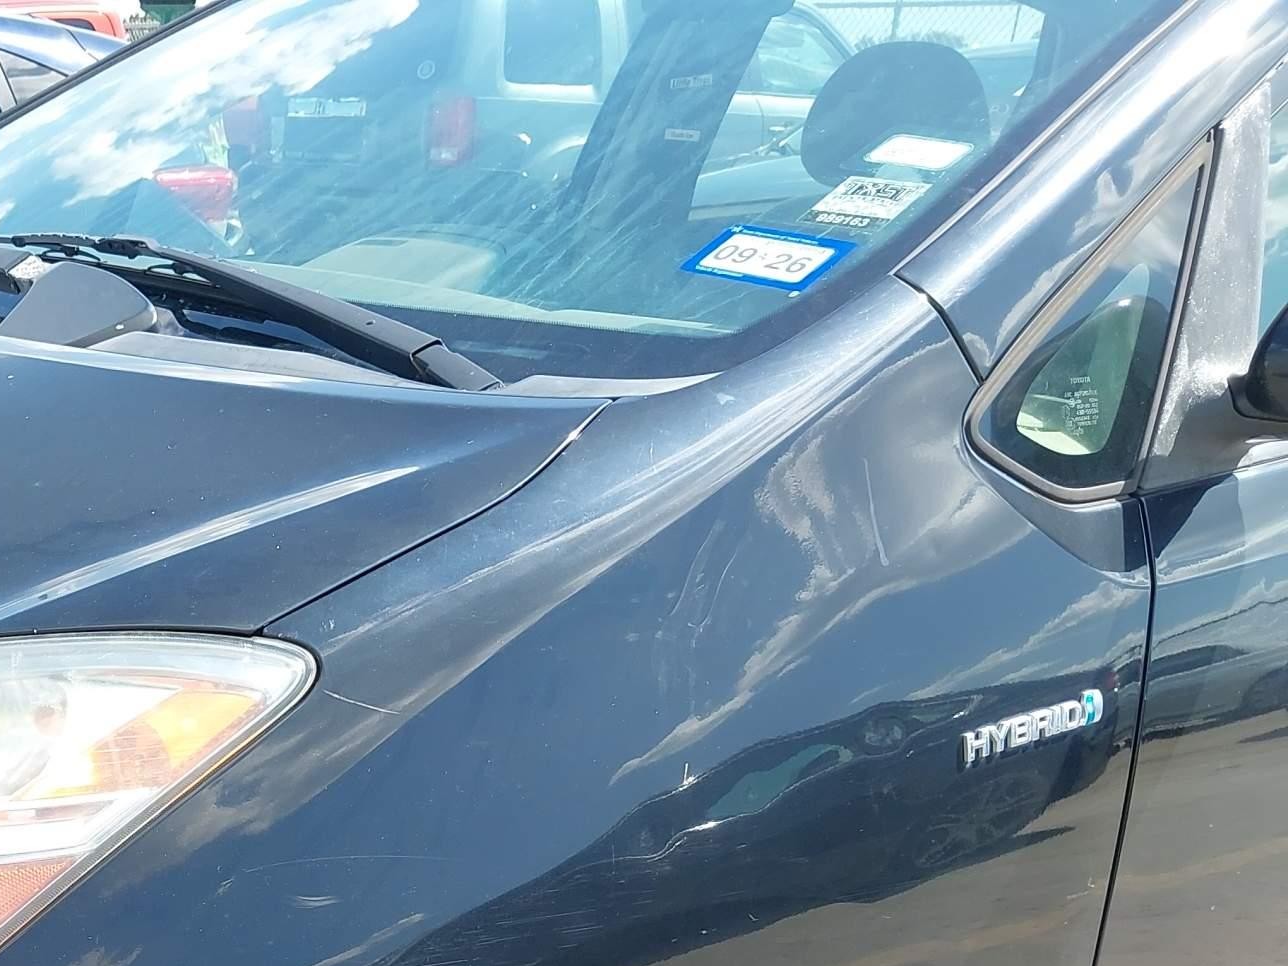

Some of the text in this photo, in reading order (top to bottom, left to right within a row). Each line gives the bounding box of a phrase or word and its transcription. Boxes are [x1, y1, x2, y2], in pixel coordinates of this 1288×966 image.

[713, 244, 758, 264] 09
[764, 253, 813, 273] 26
[1070, 376, 1091, 385] TOYOTA
[961, 699, 1083, 763] HYBRID
